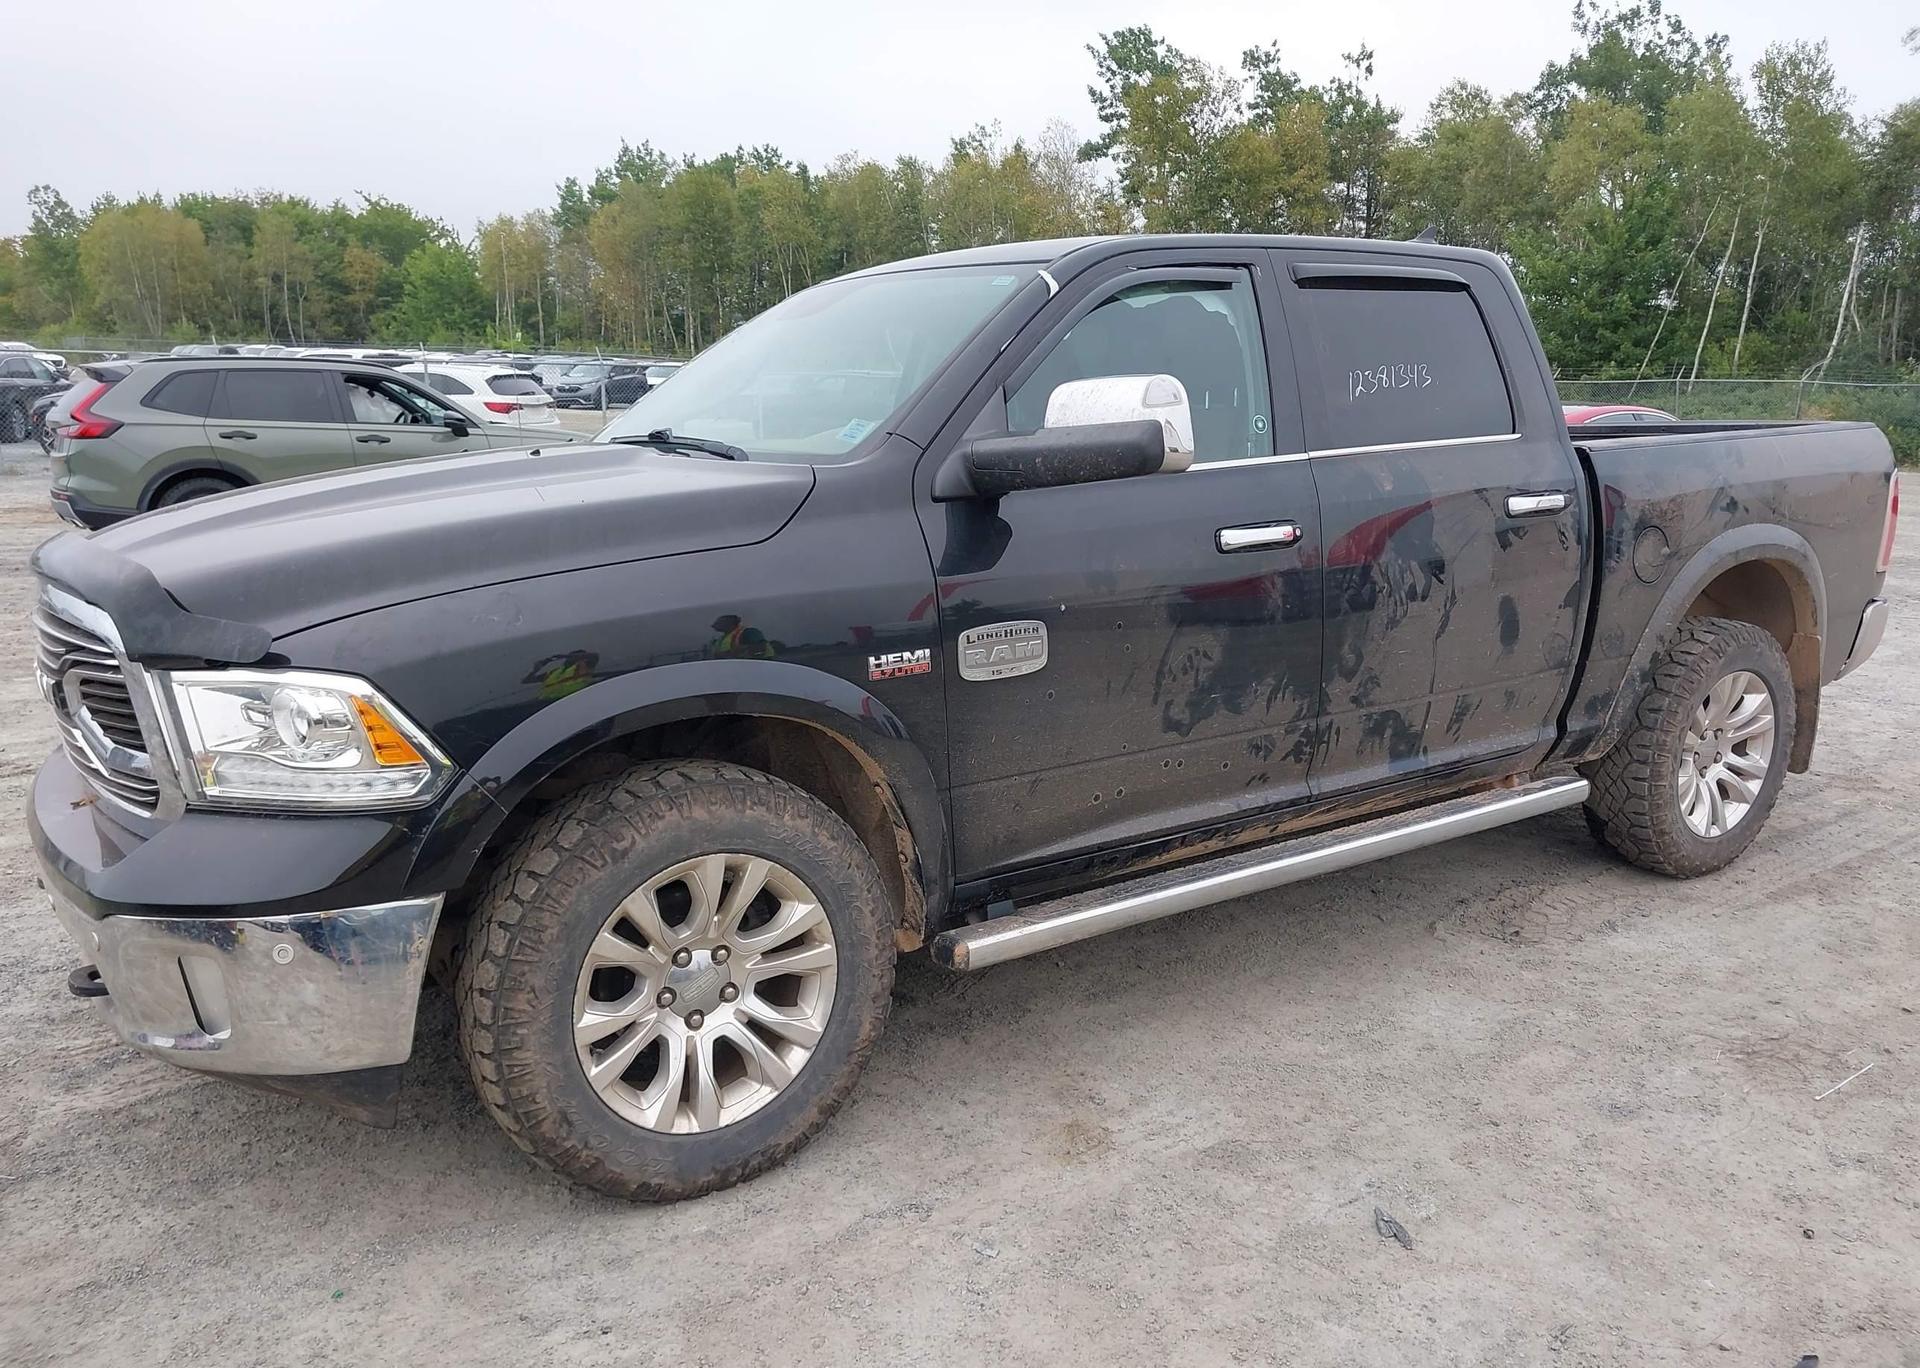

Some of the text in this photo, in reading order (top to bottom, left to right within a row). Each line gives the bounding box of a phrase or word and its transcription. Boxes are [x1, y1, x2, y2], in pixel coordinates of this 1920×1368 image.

[1349, 363, 1432, 402] 12381343
[868, 649, 930, 670] HEMI
[965, 639, 1042, 665] RAM
